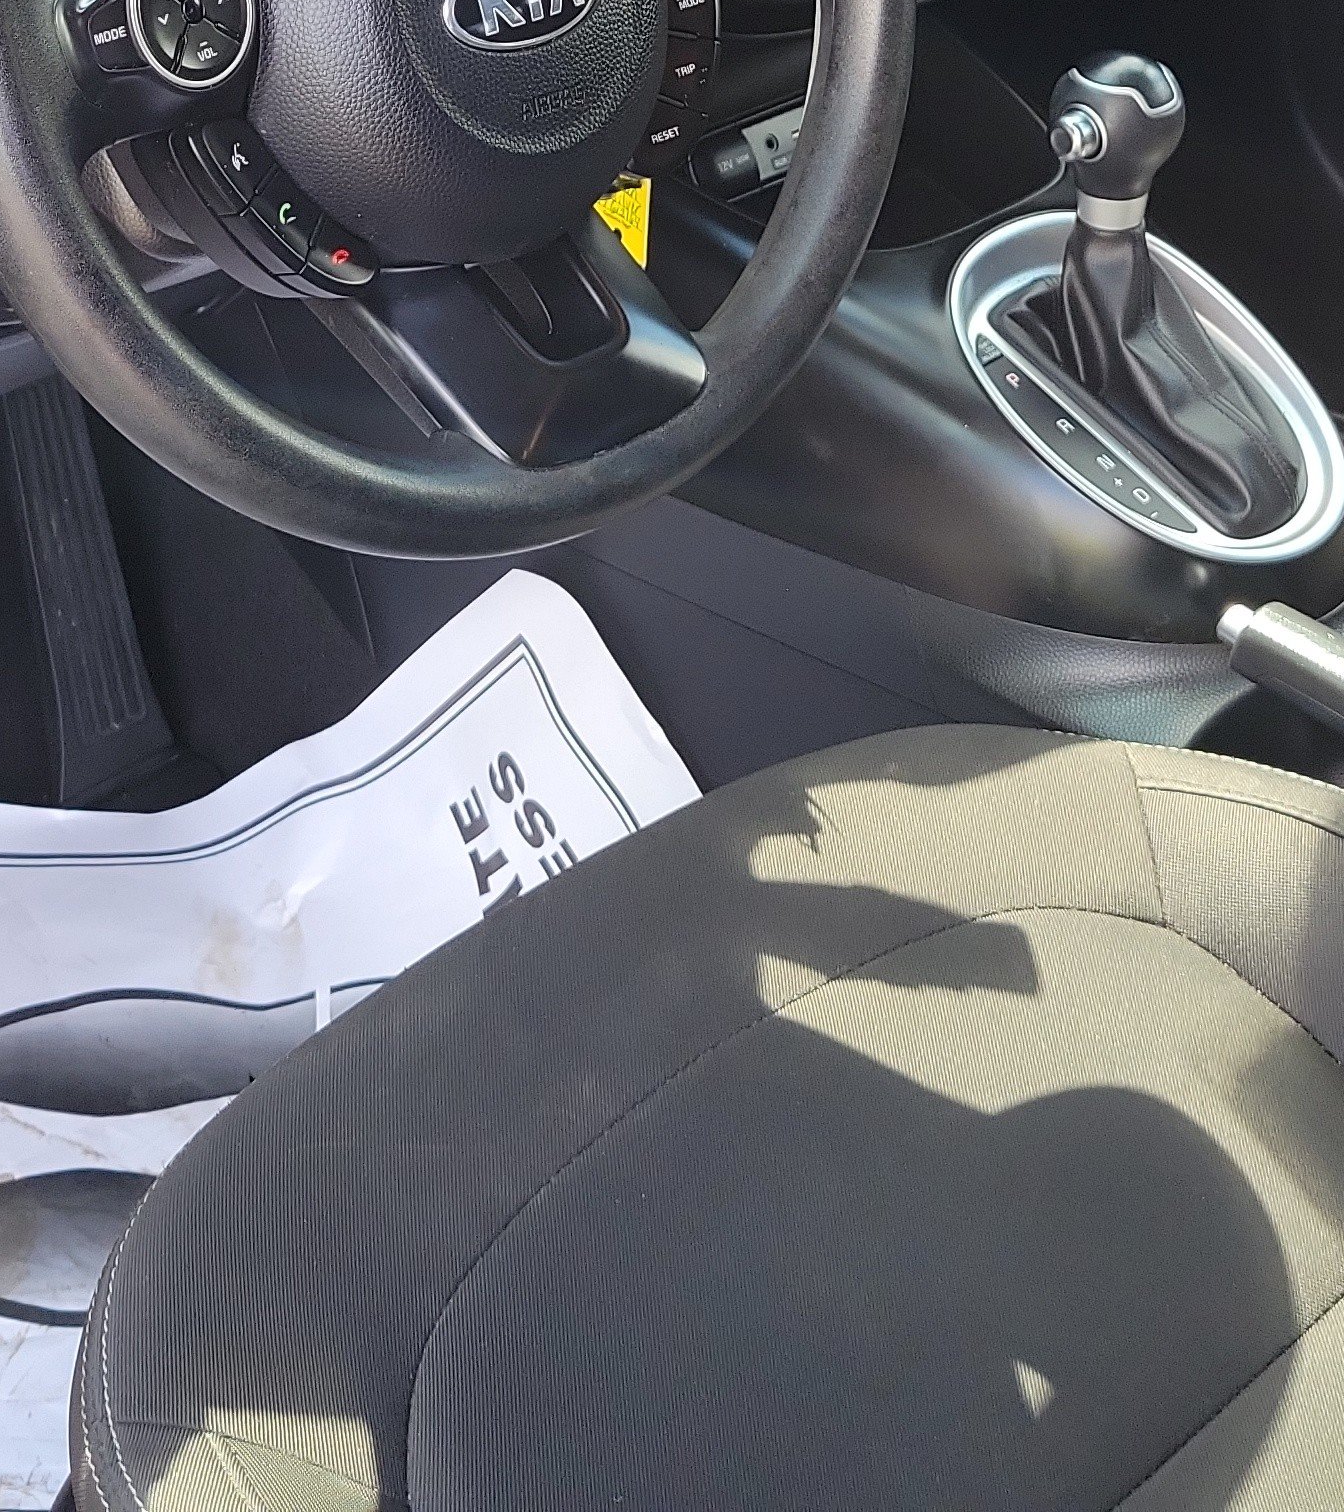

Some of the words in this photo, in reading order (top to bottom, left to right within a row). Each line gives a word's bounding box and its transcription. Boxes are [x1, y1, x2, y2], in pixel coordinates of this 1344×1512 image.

[93, 25, 128, 46] MODE
[196, 46, 218, 62] VOL
[674, 62, 697, 79] TRIP
[650, 125, 681, 145] RESET
[1005, 372, 1020, 389] P
[1056, 417, 1075, 435] R
[1096, 453, 1116, 473] N
[1132, 488, 1151, 504] D
